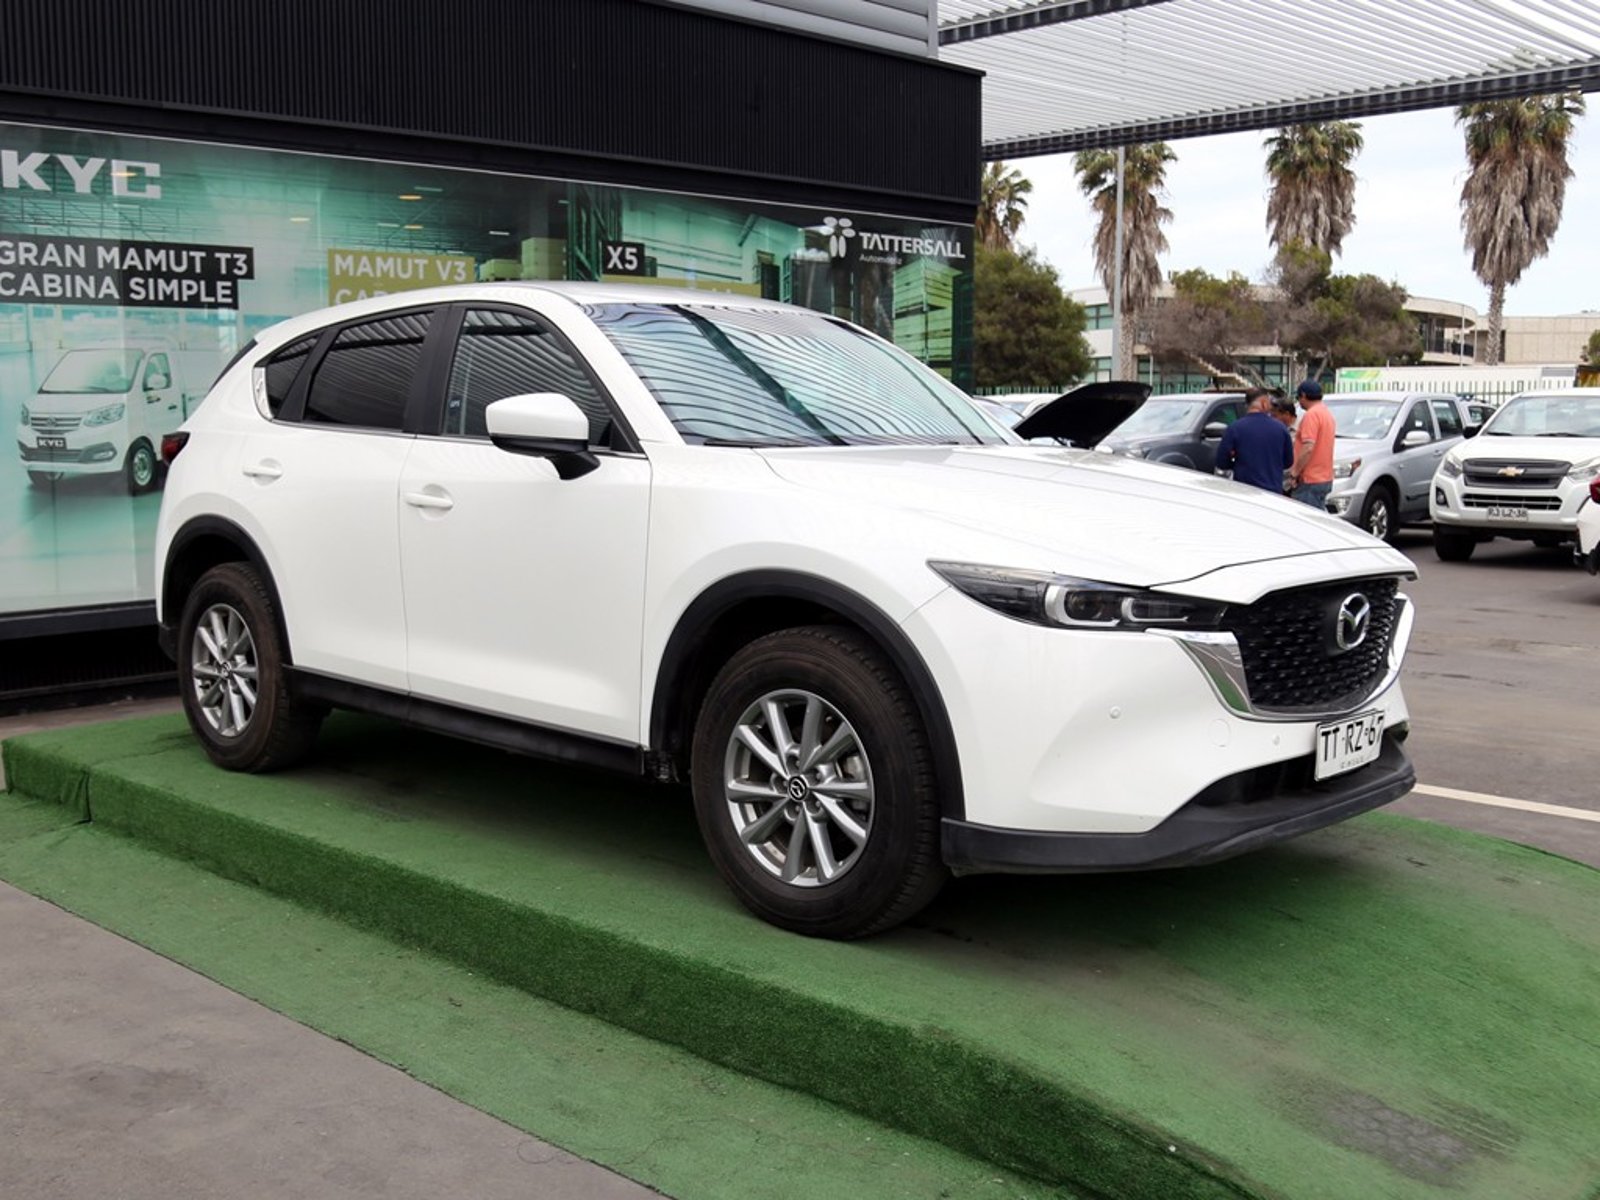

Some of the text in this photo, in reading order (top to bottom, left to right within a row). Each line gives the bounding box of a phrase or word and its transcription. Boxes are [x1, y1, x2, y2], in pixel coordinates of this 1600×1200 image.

[2, 149, 162, 199] KYC
[0, 240, 248, 276] GRAN MAMUT T3
[607, 245, 638, 271] X5
[858, 231, 966, 259] TATTERSALL
[334, 253, 467, 282] MAMUT V3
[0, 272, 234, 304] CABINA SIMPLE
[38, 438, 65, 448] KYC
